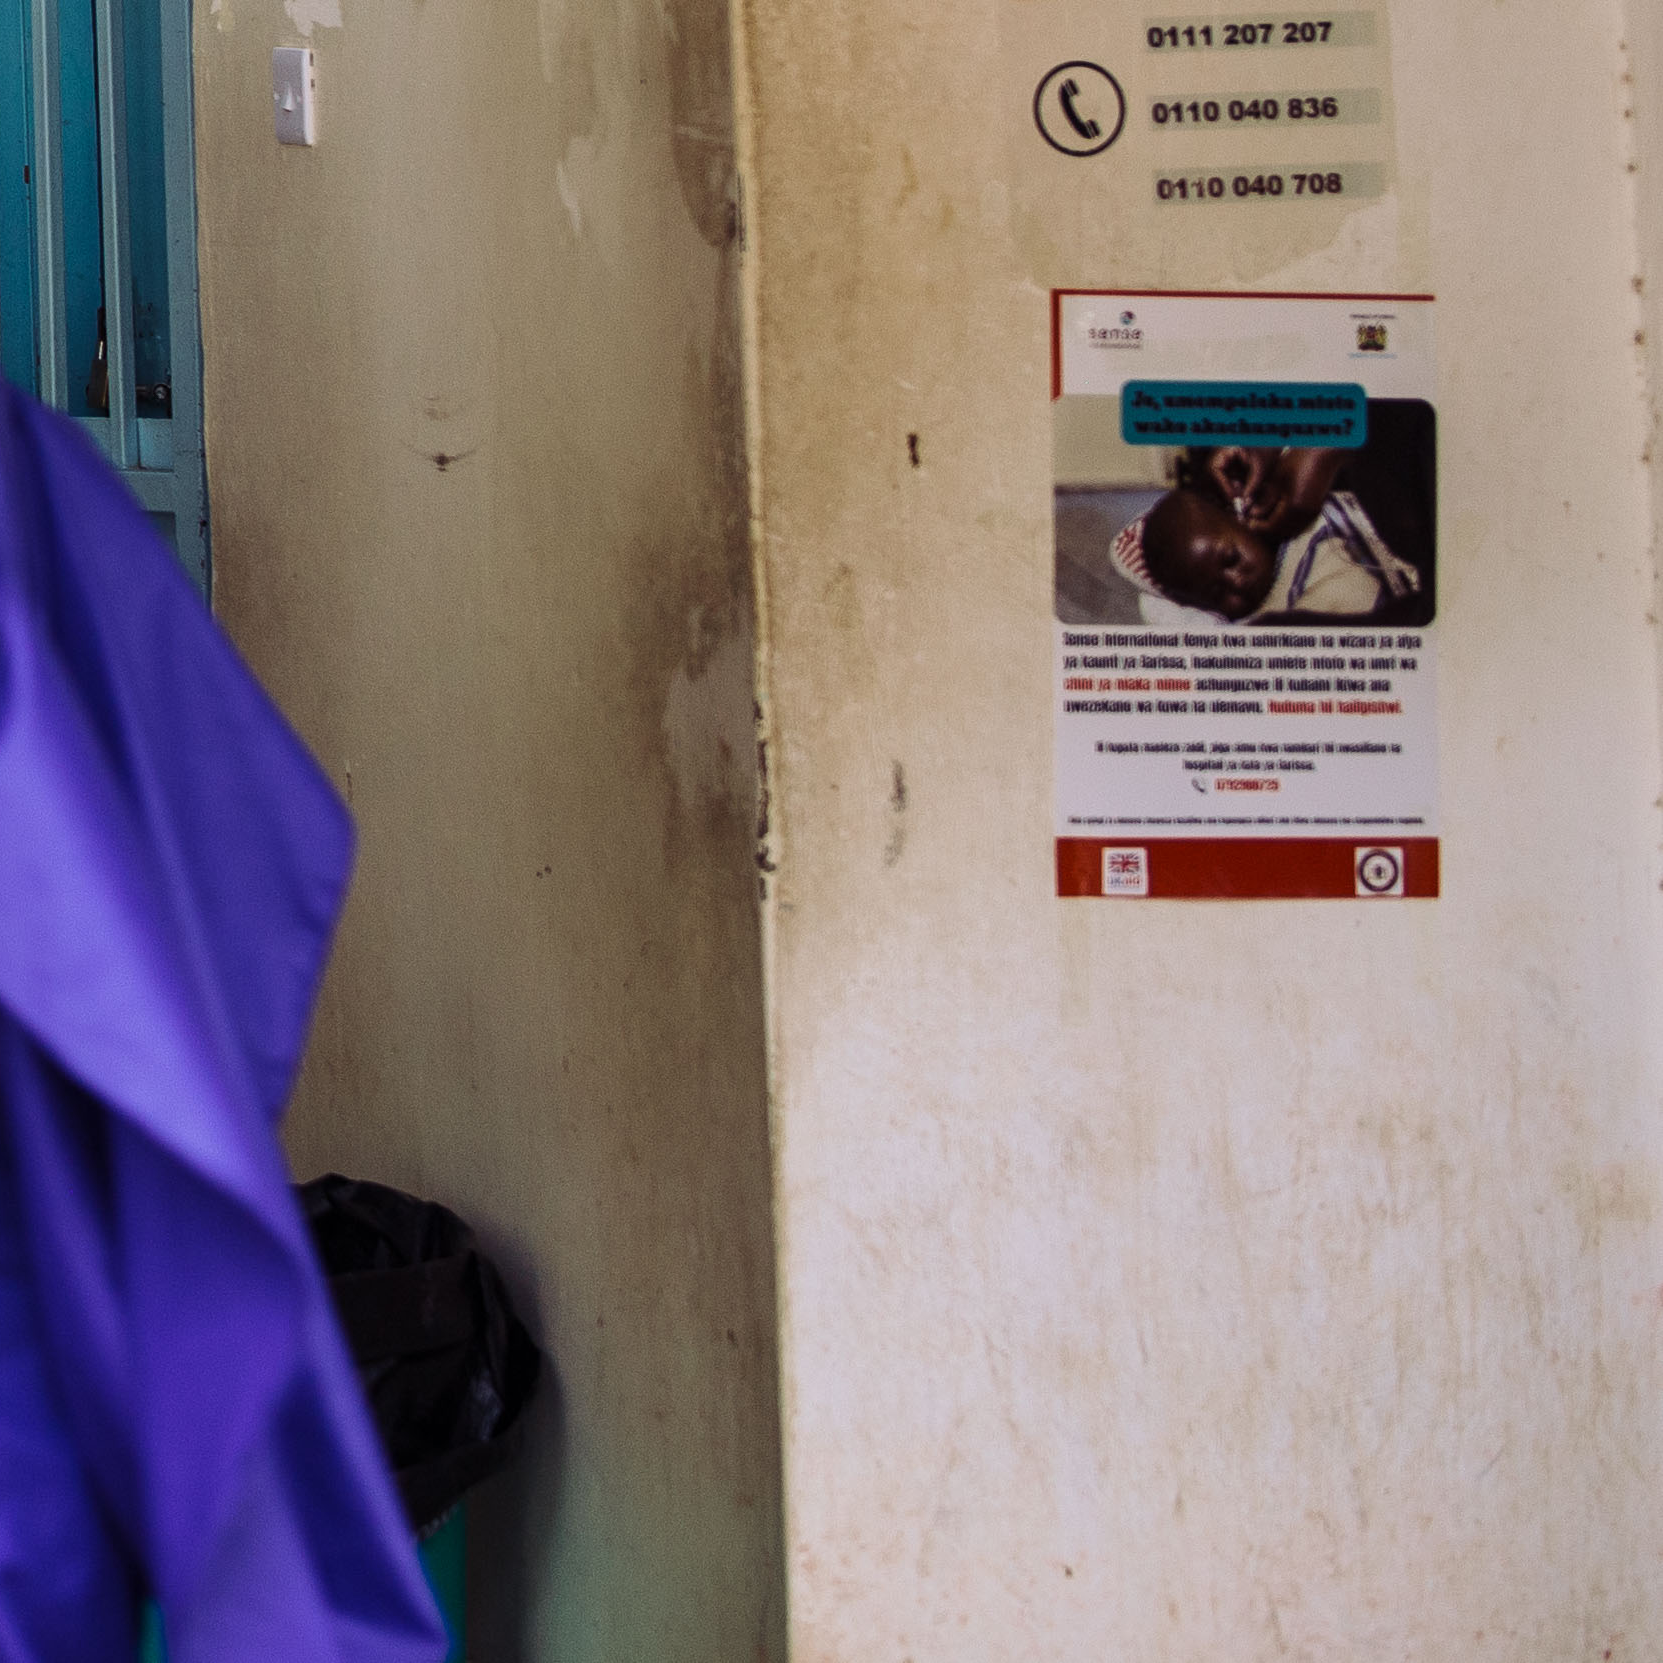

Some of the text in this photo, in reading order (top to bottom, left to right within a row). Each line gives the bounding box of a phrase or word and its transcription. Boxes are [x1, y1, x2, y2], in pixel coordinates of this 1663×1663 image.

[1146, 21, 1332, 47] 0111 207 207
[1151, 97, 1338, 123] 0110 040 836
[1156, 172, 1342, 199] 0110 040 708
